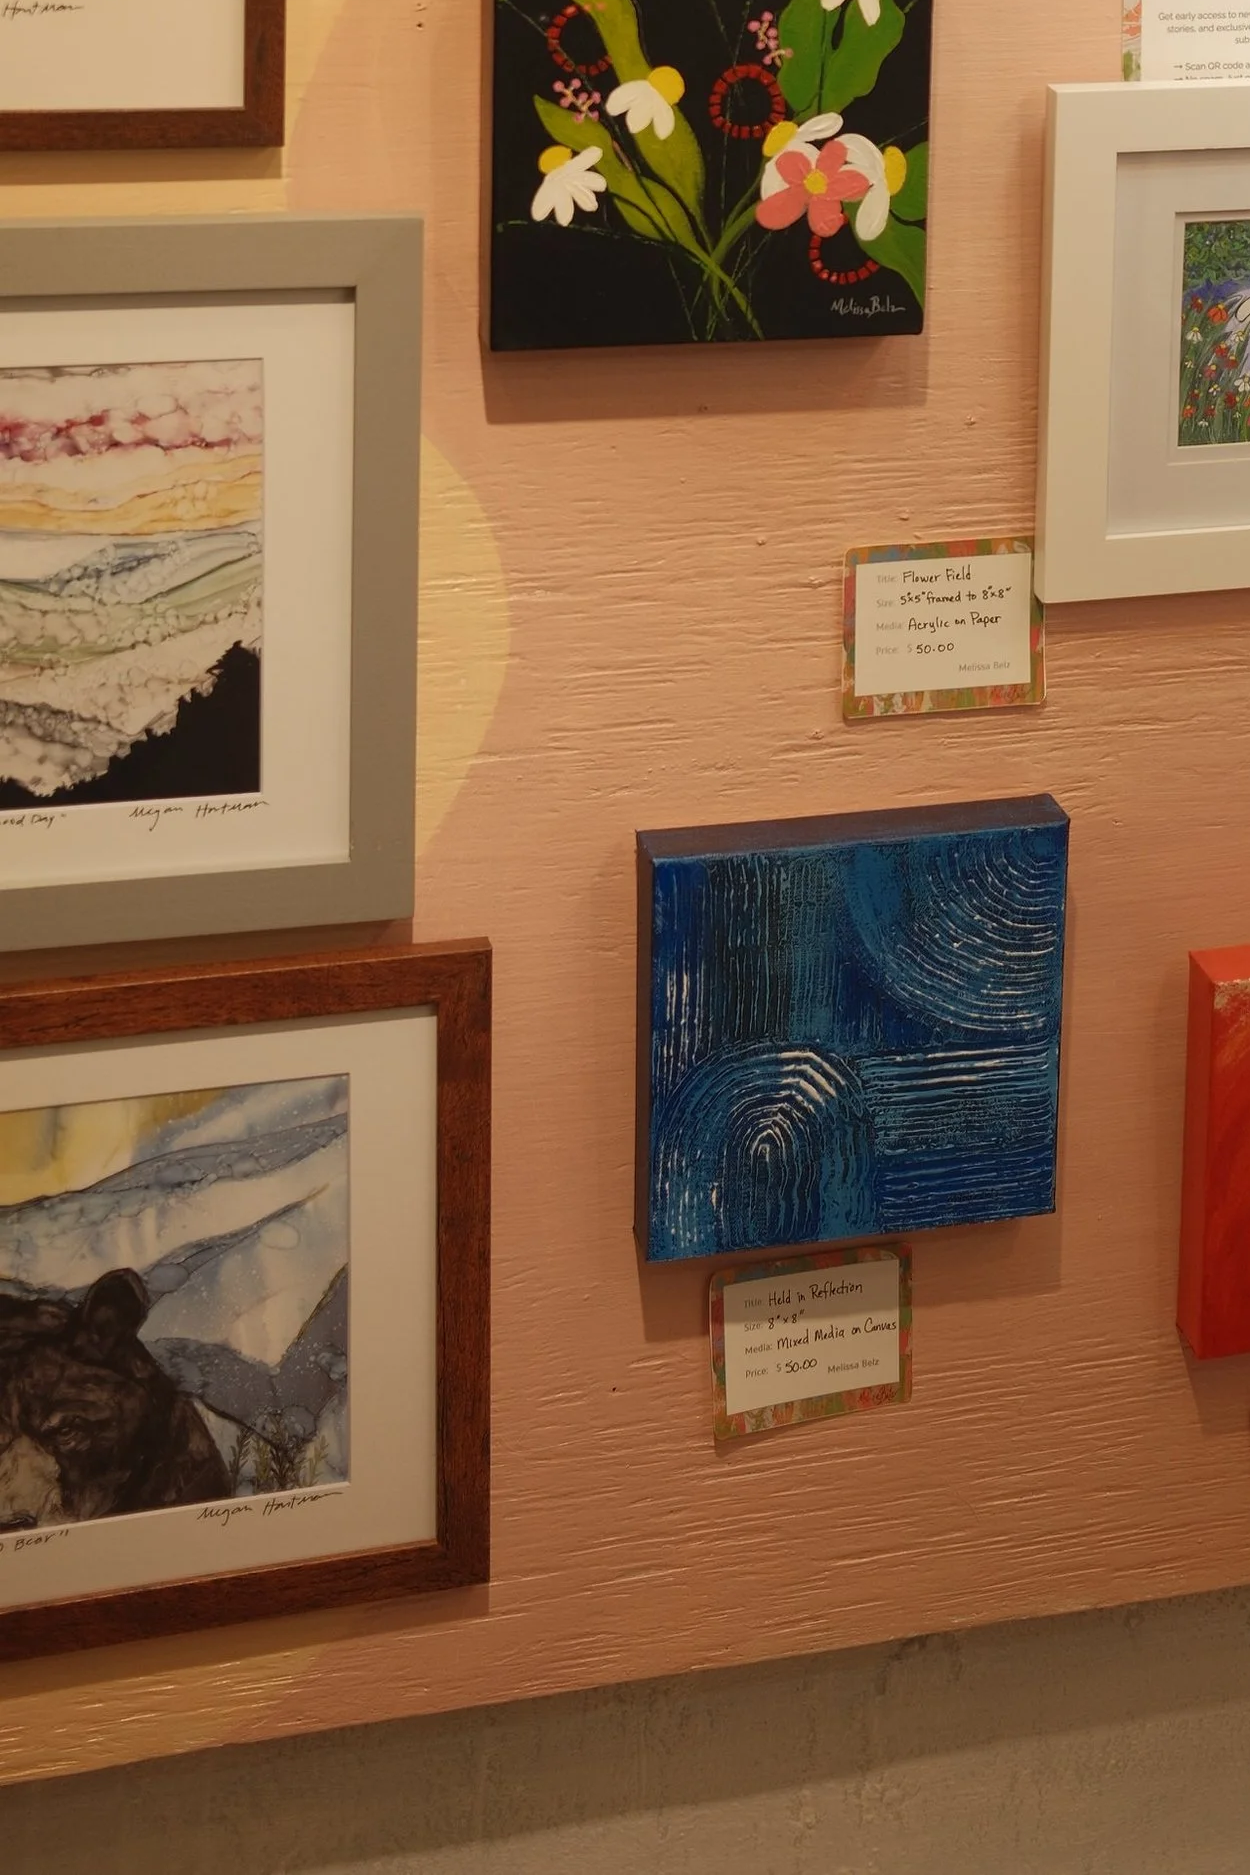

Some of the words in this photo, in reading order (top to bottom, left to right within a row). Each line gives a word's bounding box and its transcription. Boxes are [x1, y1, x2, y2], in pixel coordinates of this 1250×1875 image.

[1158, 12, 1172, 21] Get
[1175, 11, 1196, 22] early
[1198, 10, 1226, 19] access
[1228, 10, 1237, 18] to
[1198, 23, 1215, 32] and
[1185, 62, 1206, 71] Scan
[1208, 61, 1221, 70] QR
[1223, 60, 1244, 70] code
[902, 571, 940, 583] Flower
[946, 565, 971, 580] Field
[927, 590, 961, 604] framed
[967, 591, 977, 601] to
[908, 617, 950, 633] Acrylic
[970, 611, 1002, 627] Paper
[959, 662, 991, 672] Melissa
[0, 815, 25, 825] ood
[768, 1291, 791, 1306] Held
[797, 1290, 805, 1302] in
[809, 1280, 863, 1300] Reflection
[777, 1329, 810, 1350] Mixed
[815, 1325, 845, 1341] Media
[852, 1325, 861, 1334] on
[864, 1317, 897, 1333] Canvas
[828, 1363, 859, 1374] Melissa
[862, 1358, 879, 1369] Belz
